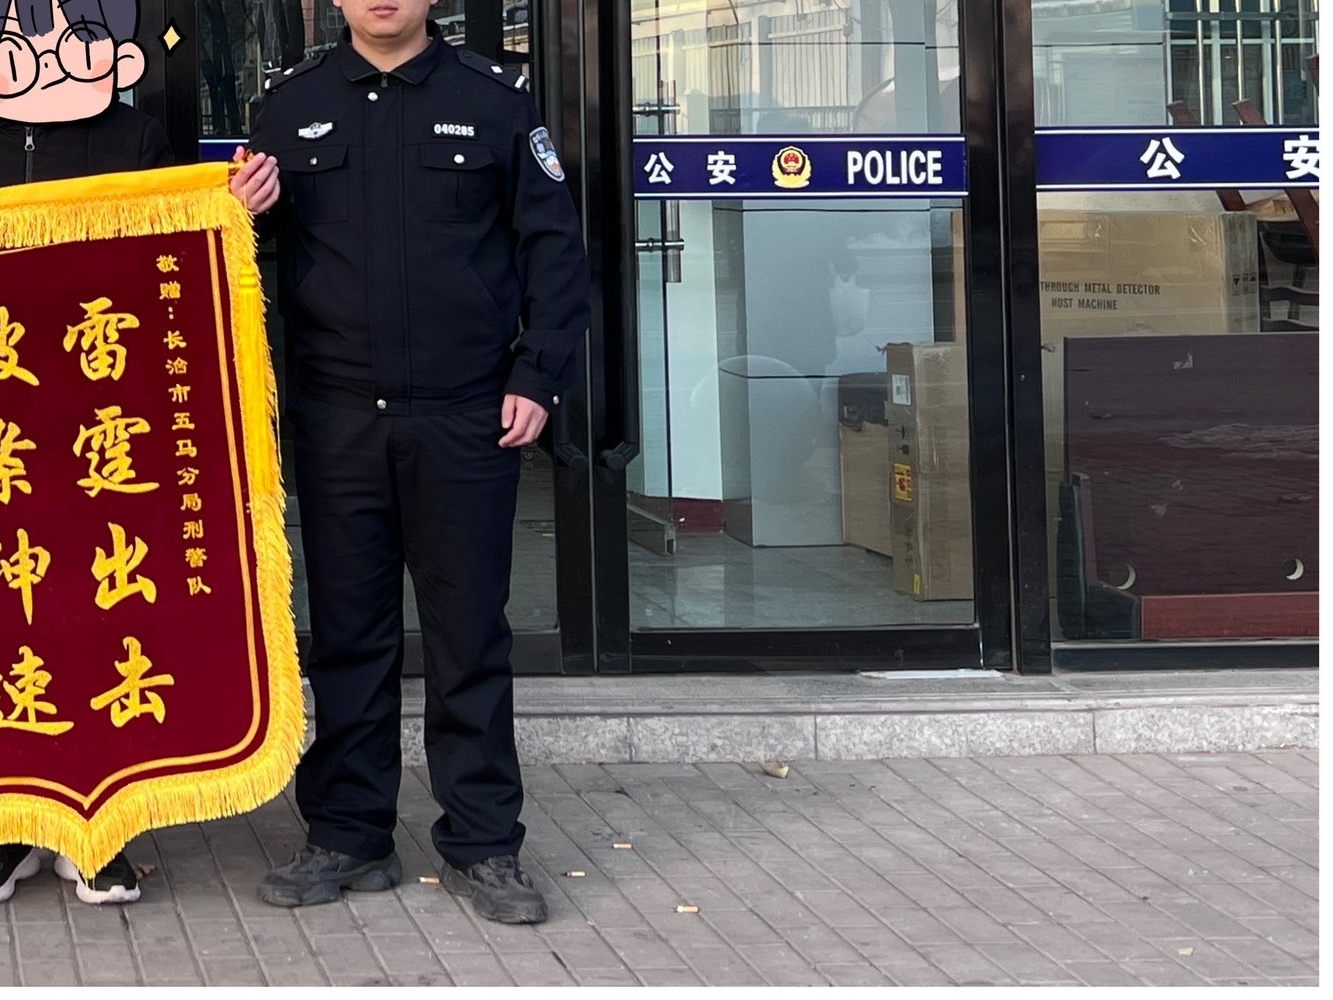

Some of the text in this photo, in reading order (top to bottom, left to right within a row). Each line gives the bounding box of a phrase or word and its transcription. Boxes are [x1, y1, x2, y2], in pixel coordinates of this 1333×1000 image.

[433, 123, 475, 137] 040285
[643, 149, 943, 185] 公安 POLICE
[1139, 134, 1320, 180] 公安
[1041, 281, 1161, 296] THROUGH METAL DETECTOR
[1051, 297, 1118, 311] HOST MACHINE
[62, 296, 175, 728] 雷霆出击
